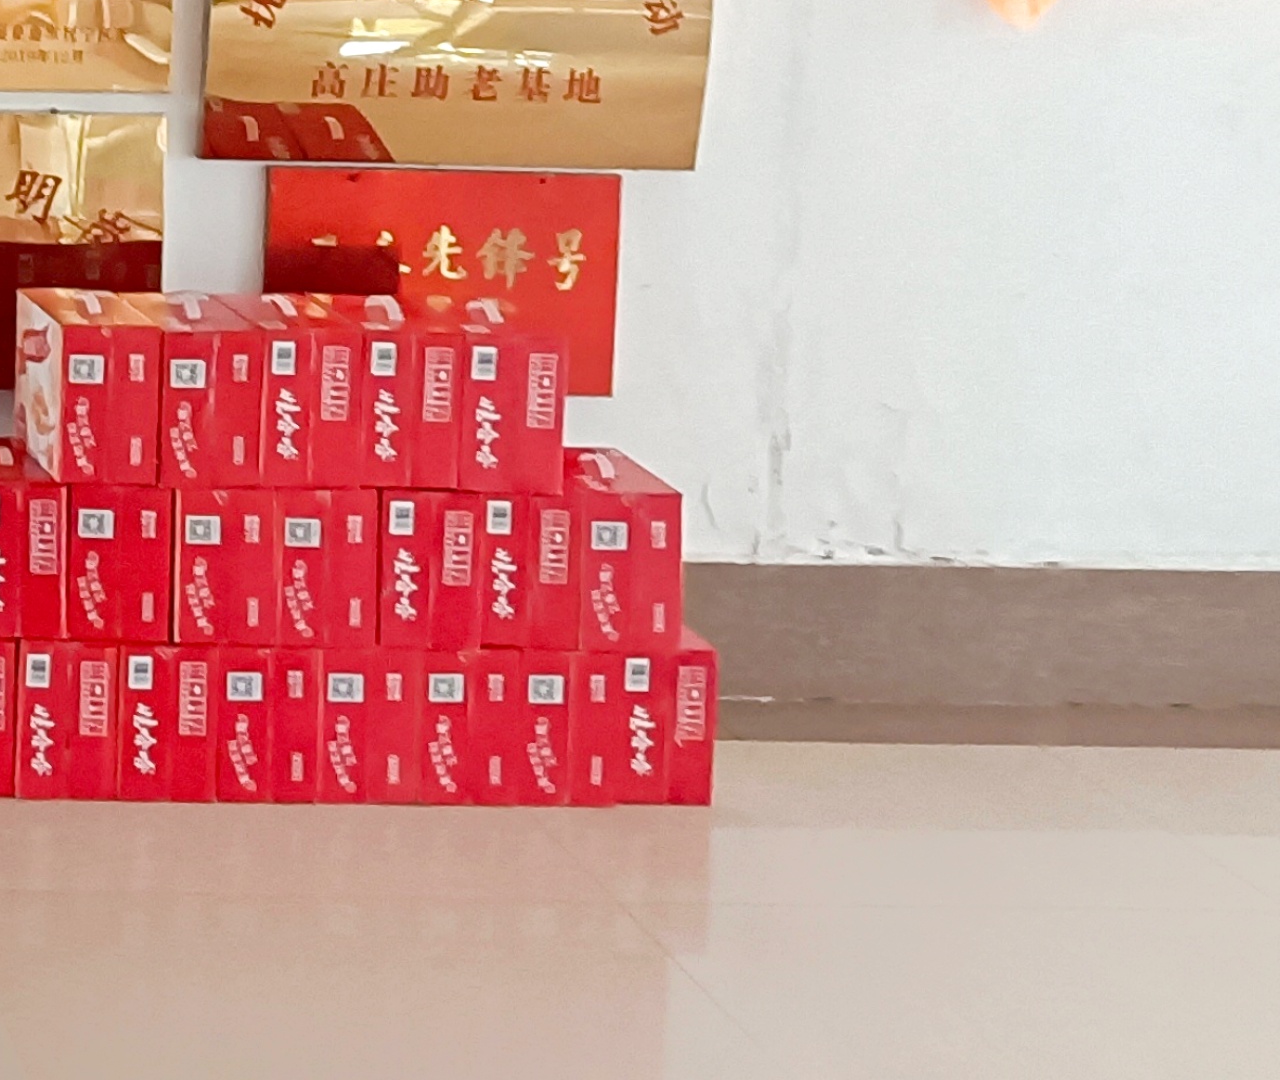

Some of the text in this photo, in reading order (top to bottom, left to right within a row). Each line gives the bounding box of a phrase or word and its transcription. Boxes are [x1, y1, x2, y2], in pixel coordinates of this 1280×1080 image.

[310, 61, 603, 105] 高庄助老基地
[311, 224, 587, 291] 先锋号
